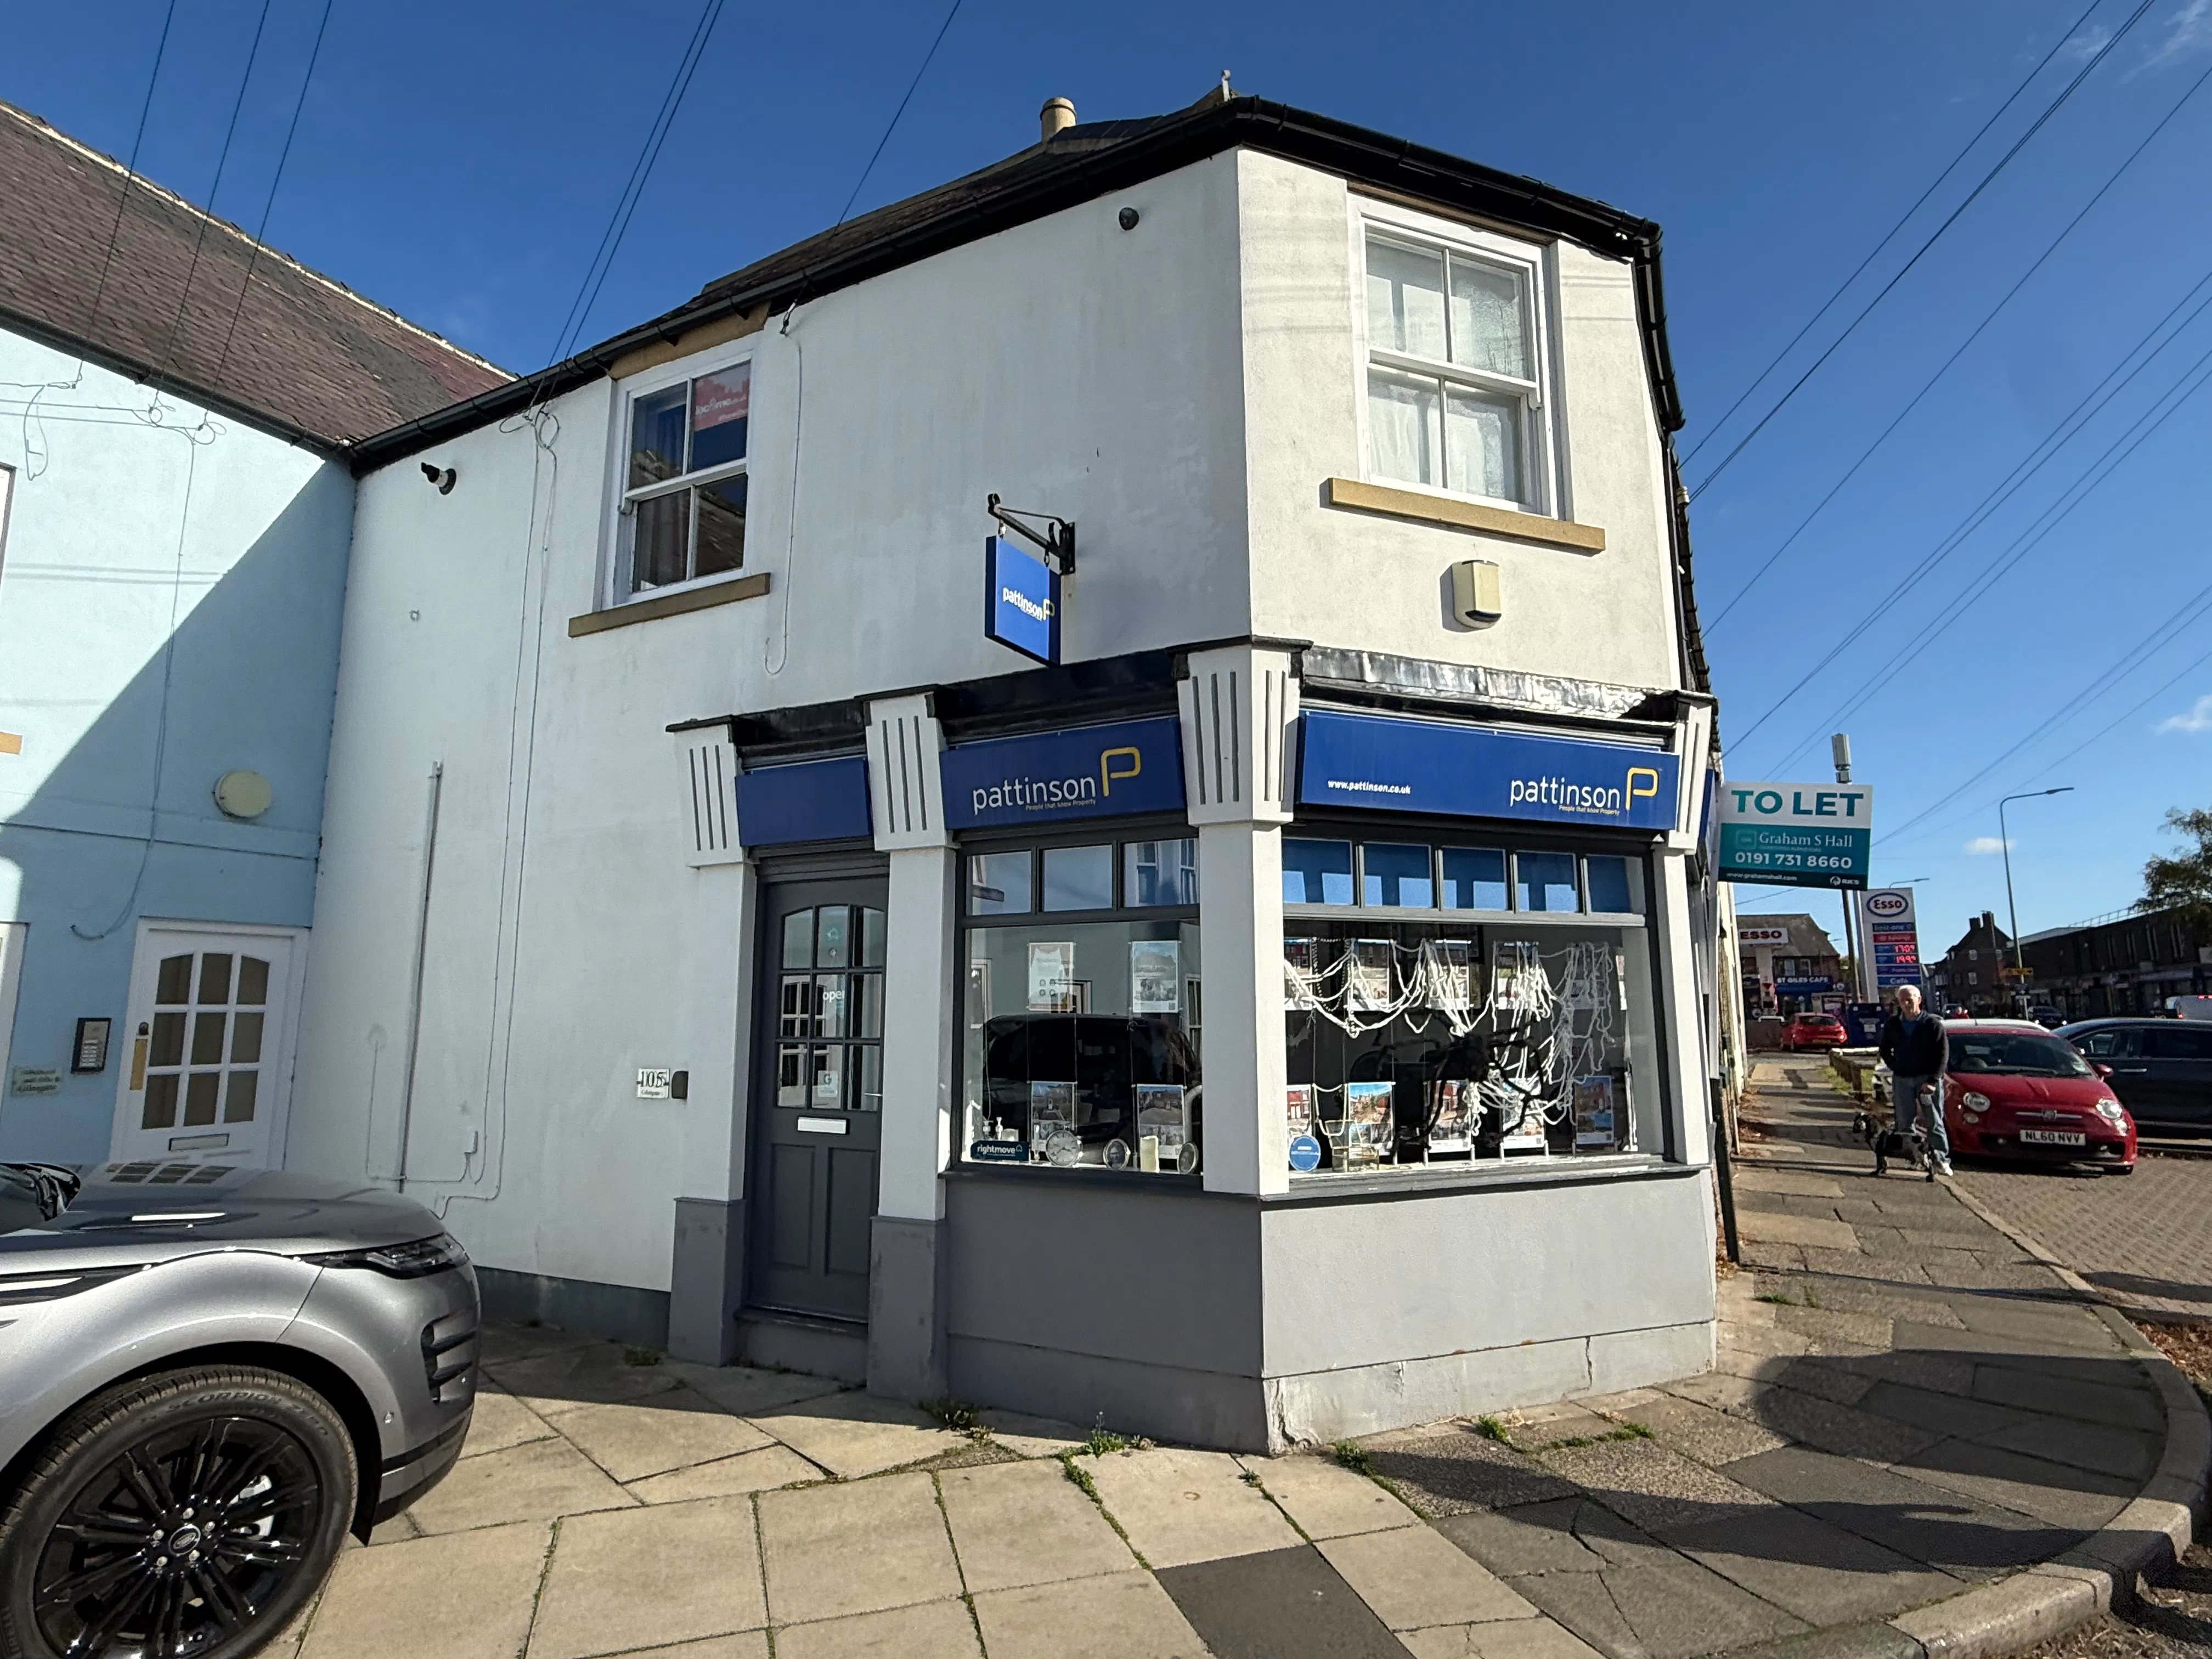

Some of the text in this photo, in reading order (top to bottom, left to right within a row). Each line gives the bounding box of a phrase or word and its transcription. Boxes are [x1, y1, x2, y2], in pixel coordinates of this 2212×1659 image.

[1003, 588, 1042, 619] pattinson
[1328, 780, 1412, 794] www.pattinson.co.uk
[1510, 775, 1621, 809] pattinson
[973, 777, 1096, 816] pattinson
[1073, 798, 1096, 806] Property
[1731, 790, 1864, 817] TO LET
[1759, 831, 1853, 848] Graham S Hall
[1735, 852, 1852, 869] 0191 731 8660
[1726, 872, 1797, 881] www.grahamshall.com
[1740, 930, 1782, 940] ESSO
[641, 1071, 667, 1088] 105
[2025, 1132, 2080, 1143] NL60 NVV
[977, 1144, 1016, 1155] rightmove
